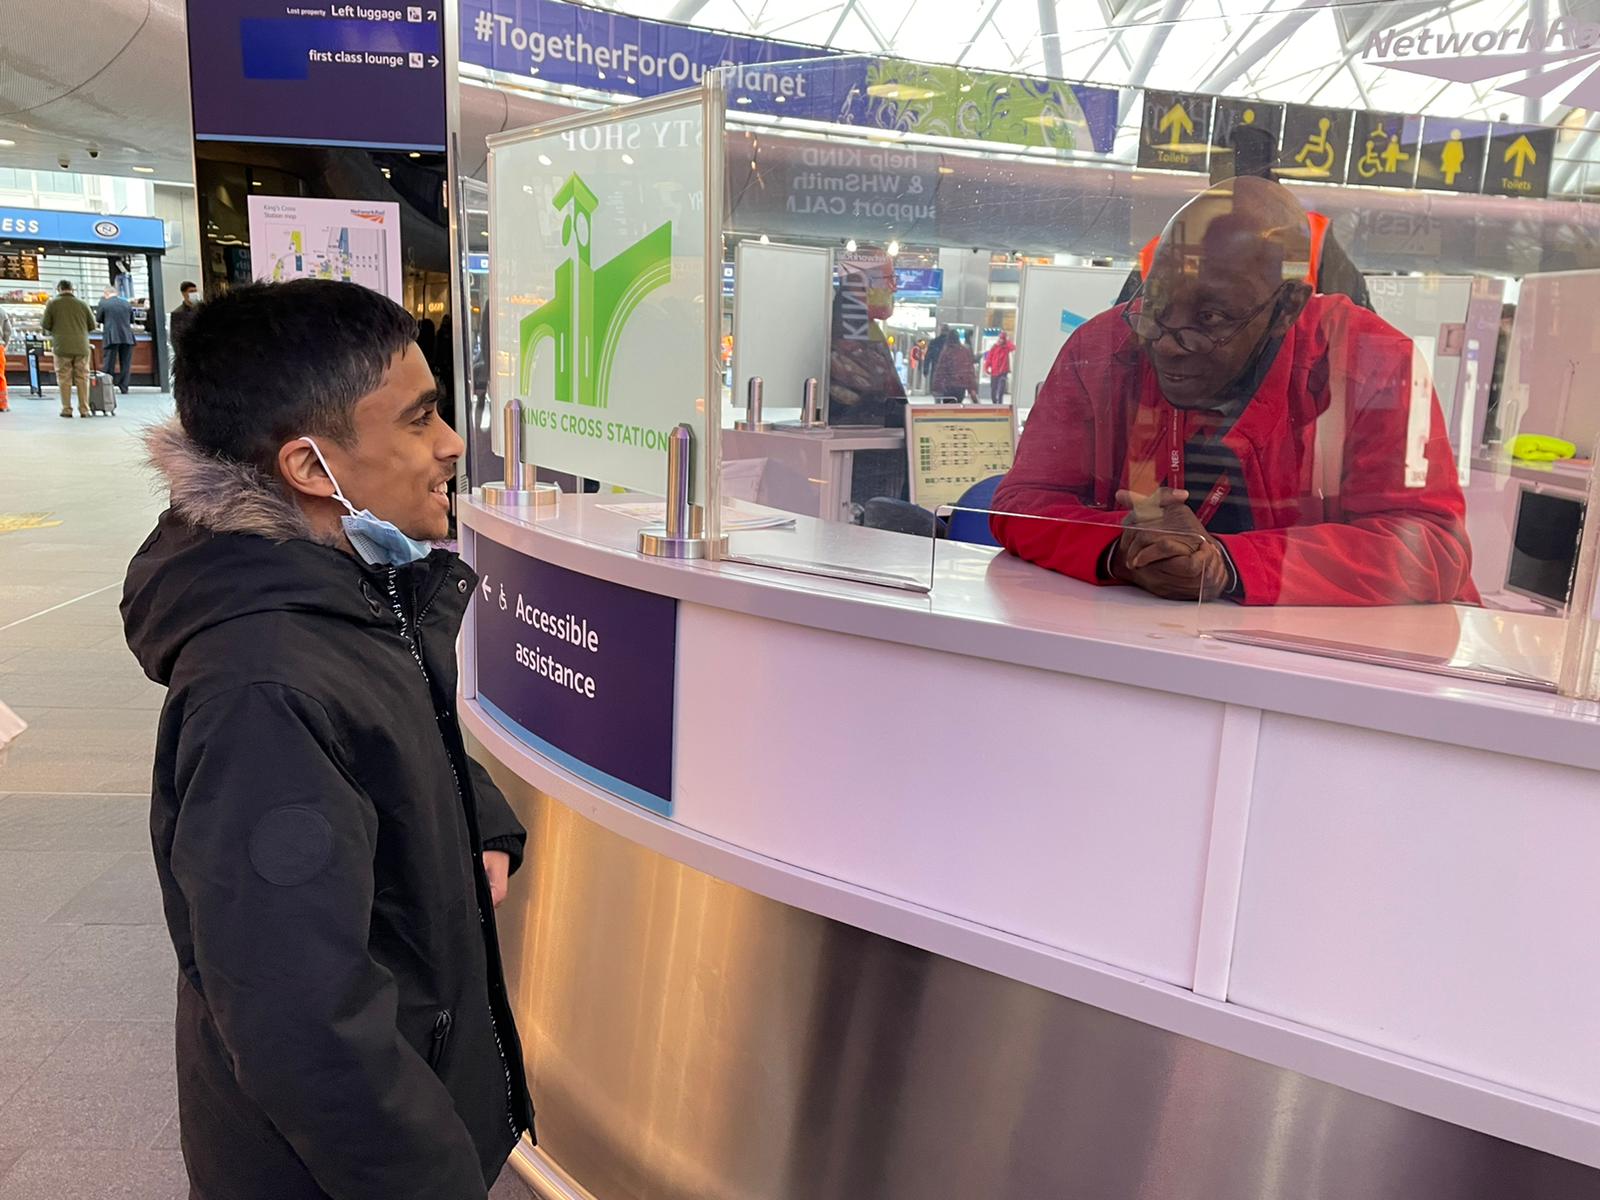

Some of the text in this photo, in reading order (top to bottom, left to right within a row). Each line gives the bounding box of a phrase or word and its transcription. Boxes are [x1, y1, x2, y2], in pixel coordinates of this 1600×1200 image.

[286, 7, 326, 17] Lost property
[331, 5, 402, 21] Left luggage
[309, 49, 404, 67] first class lounge
[474, 11, 807, 98] #TogetherForOuPlanet
[1157, 150, 1189, 164] Toilets
[1501, 177, 1532, 192] Toilets
[2, 218, 40, 233] ESS
[520, 407, 668, 452] KING'S CROSS STATION
[1171, 449, 1180, 472] LNER
[515, 593, 600, 654] Accessible
[514, 641, 597, 700] assistance
